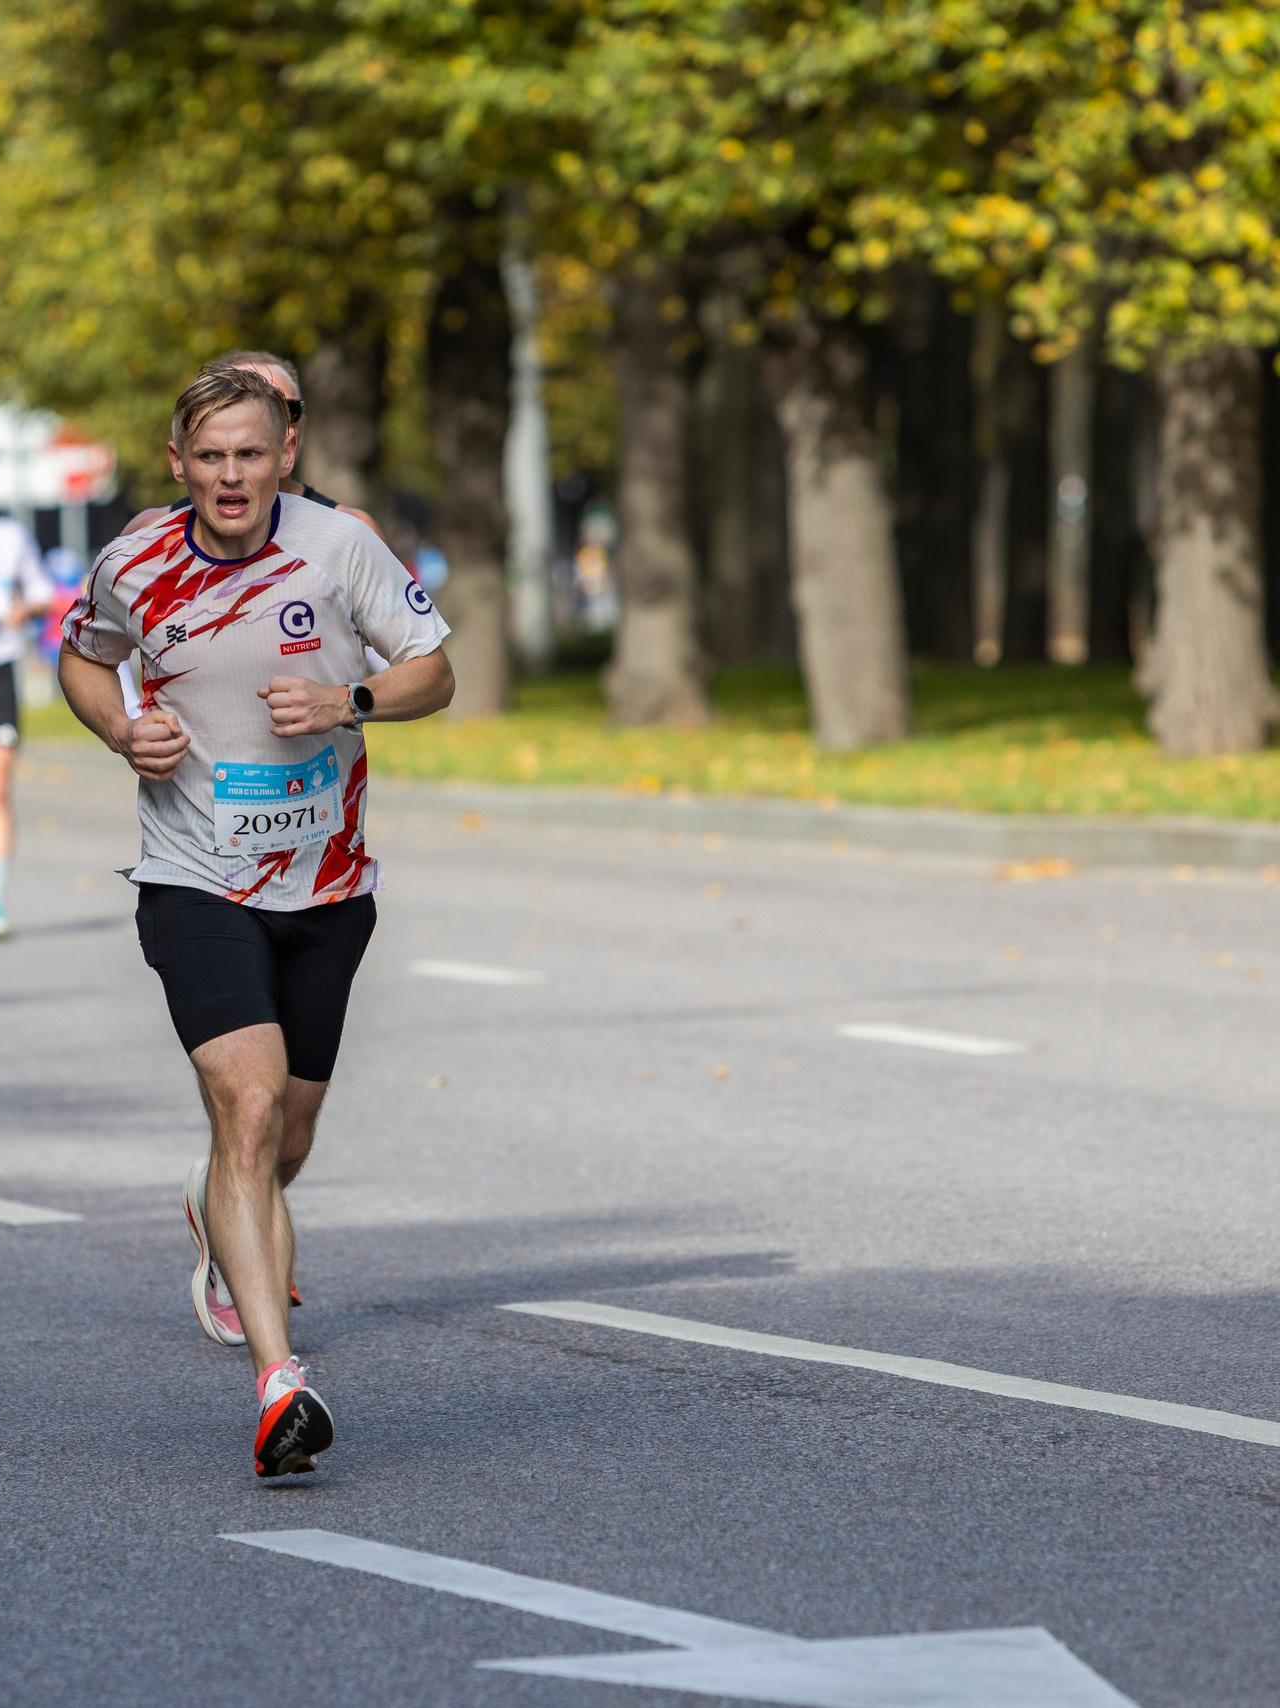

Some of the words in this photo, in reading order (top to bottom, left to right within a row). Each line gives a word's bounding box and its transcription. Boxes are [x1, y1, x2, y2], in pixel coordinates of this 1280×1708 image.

[282, 641, 320, 654] NUTREND
[244, 788, 280, 796] СТОЛИЦА
[233, 804, 315, 835] 20971
